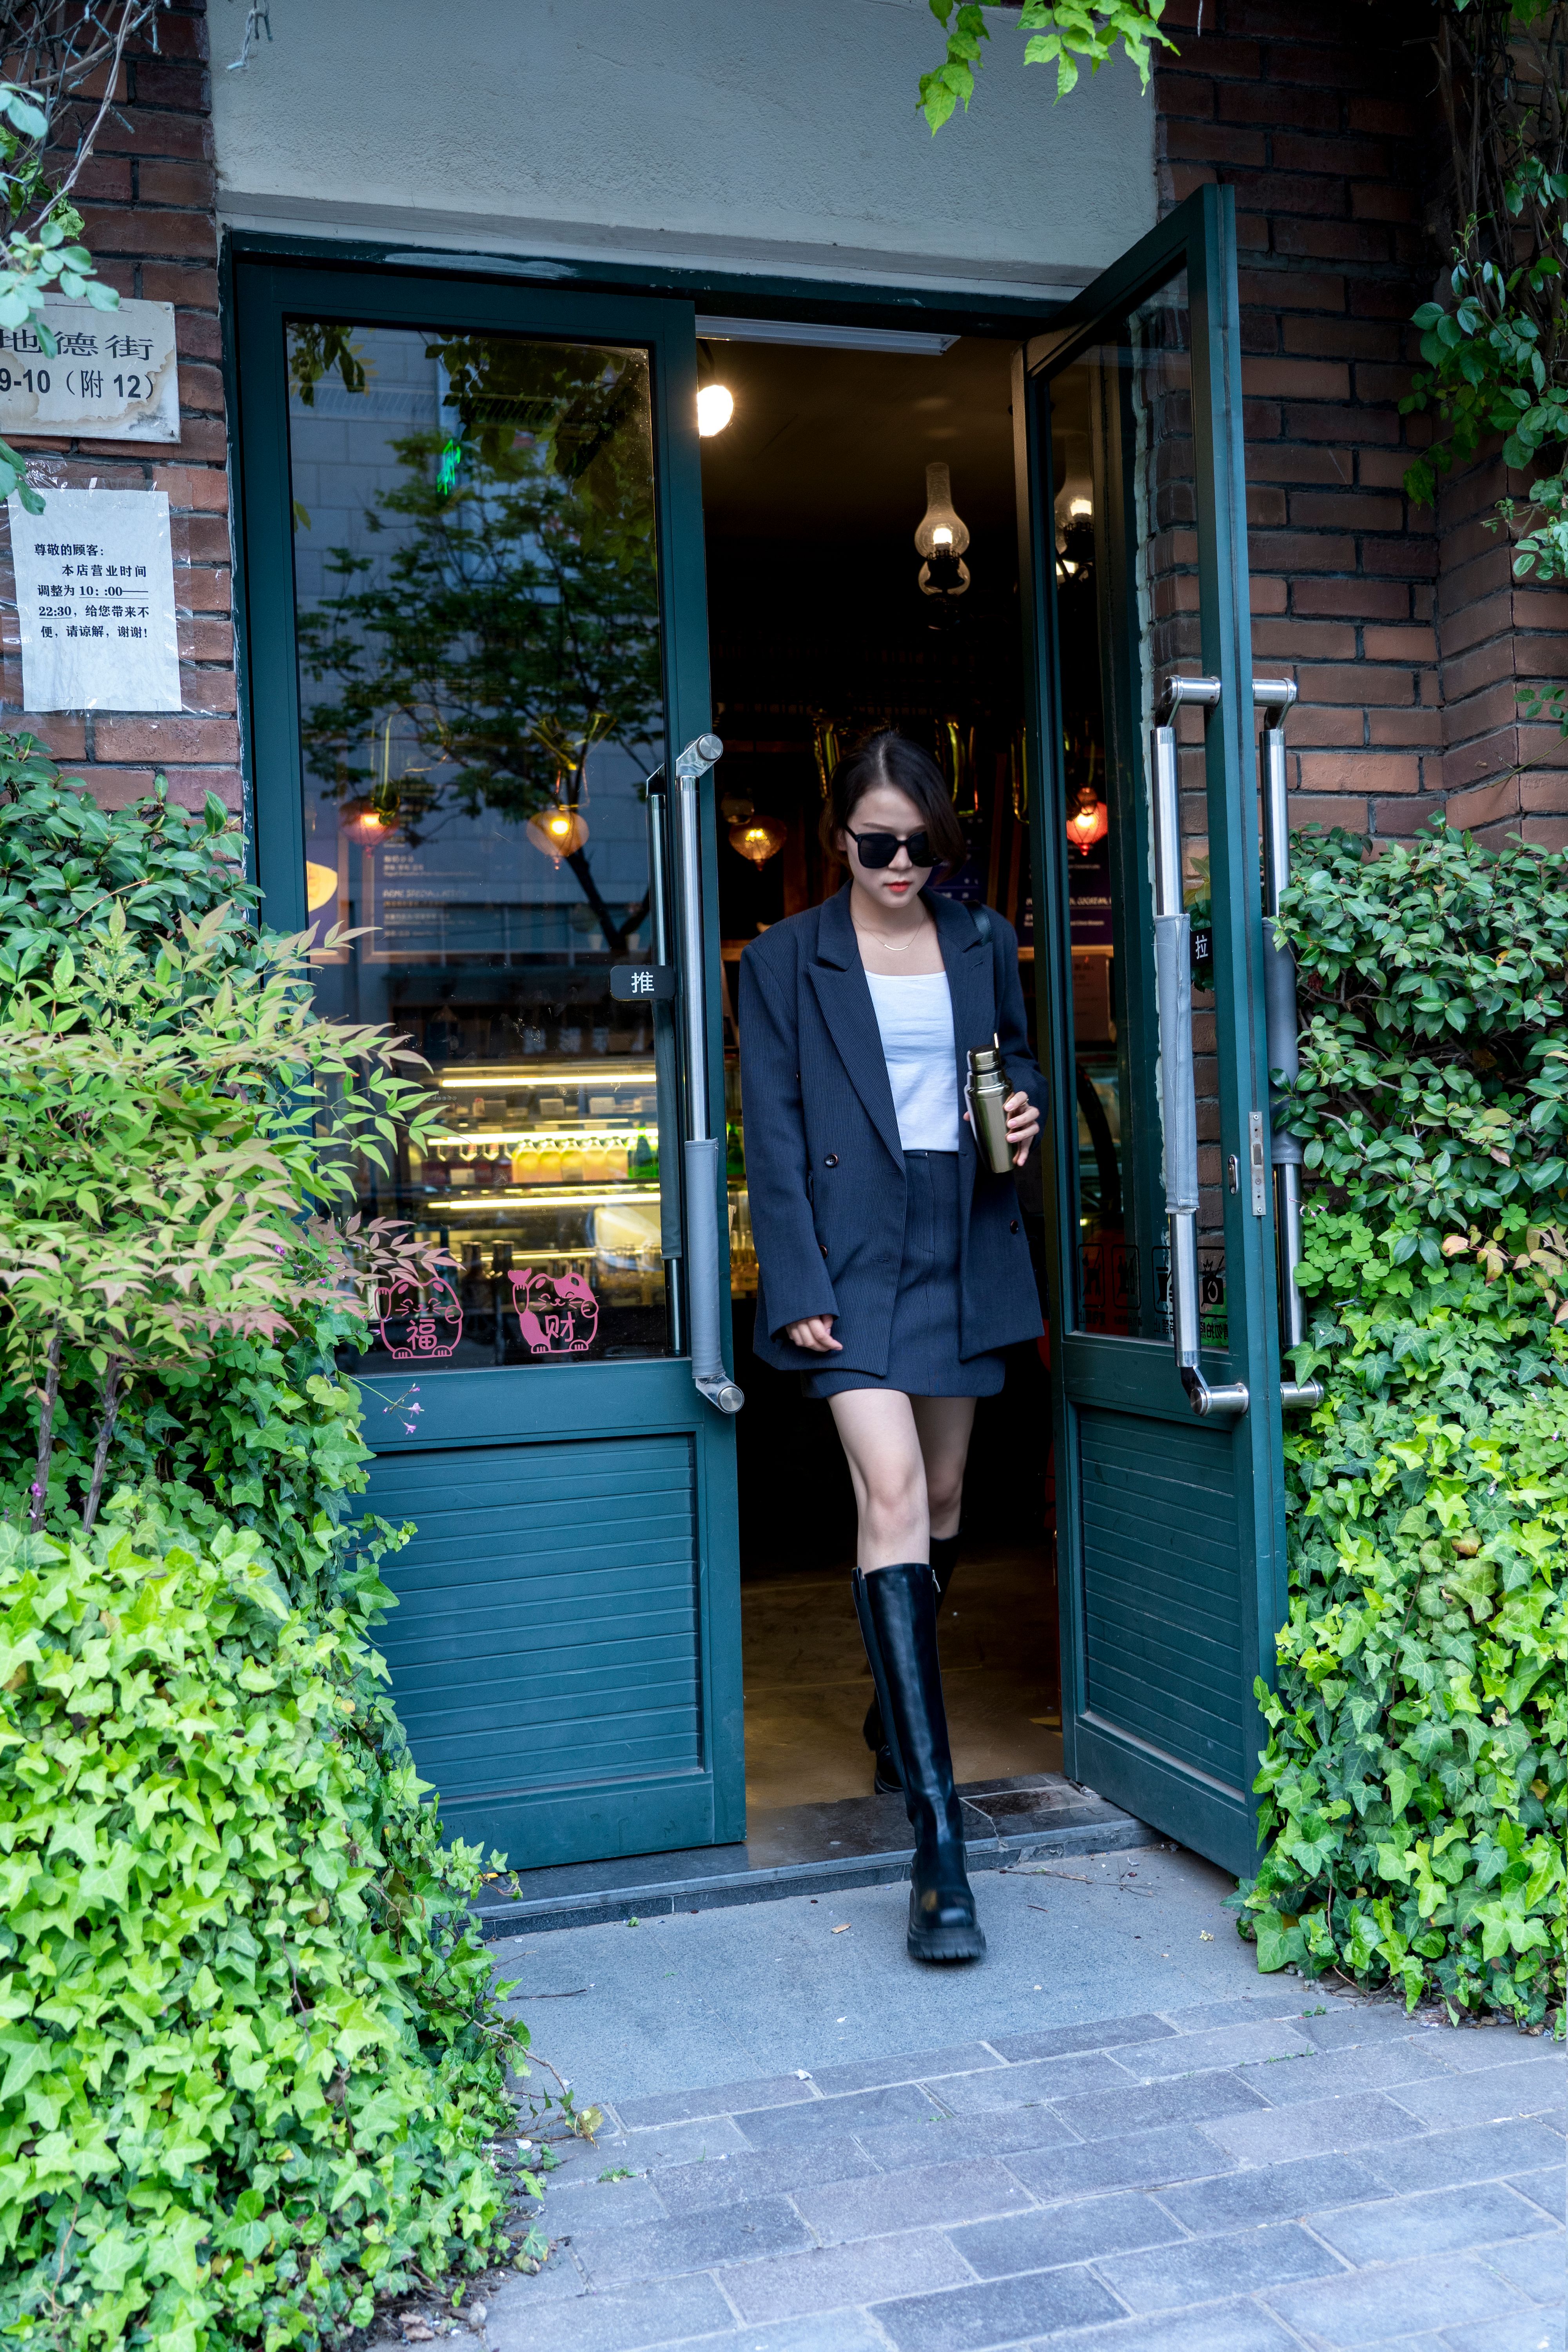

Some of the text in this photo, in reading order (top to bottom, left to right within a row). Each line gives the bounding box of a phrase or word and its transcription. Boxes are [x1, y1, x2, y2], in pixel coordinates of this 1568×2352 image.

[34, 543, 103, 556] 尊敬的顾客：
[62, 564, 147, 577] 本店营业时间
[1195, 935, 1208, 960] 拉
[631, 971, 655, 994] 推
[406, 1318, 438, 1350] 福
[544, 1311, 576, 1343] 财
